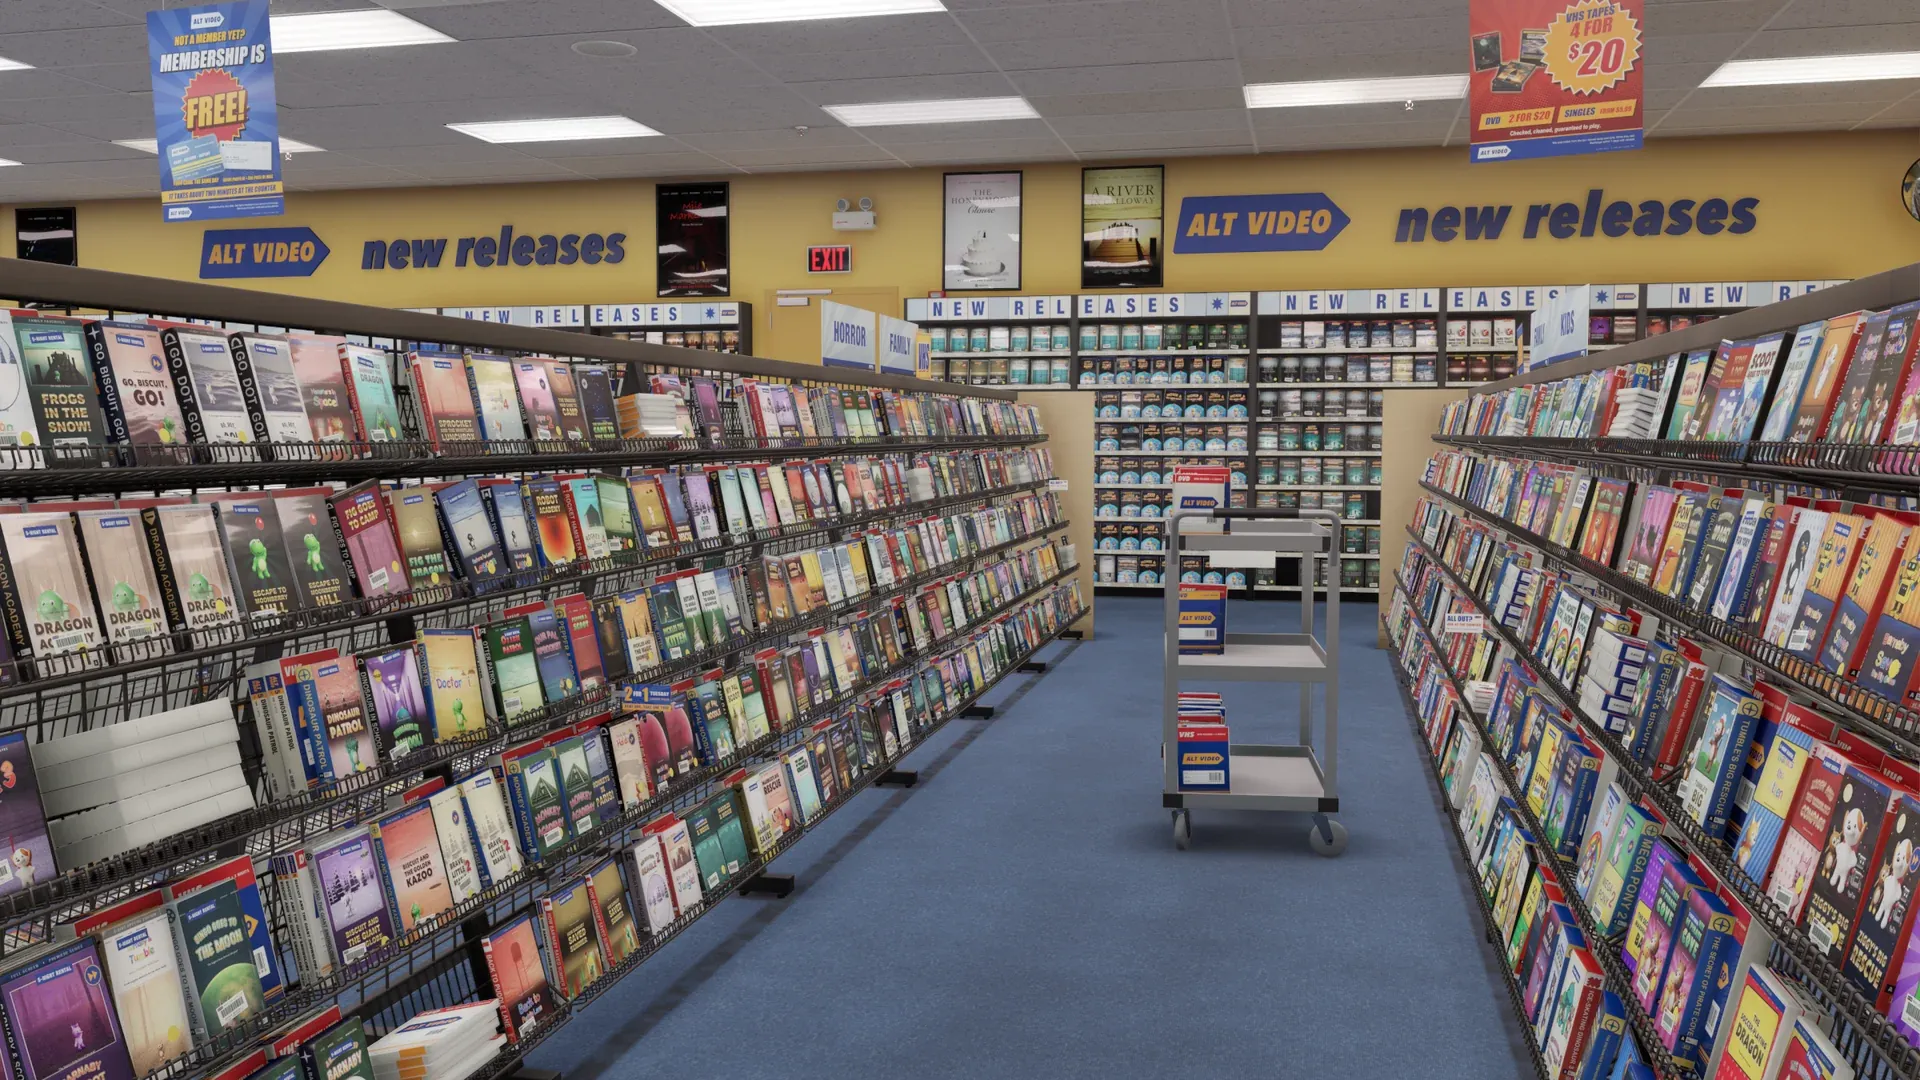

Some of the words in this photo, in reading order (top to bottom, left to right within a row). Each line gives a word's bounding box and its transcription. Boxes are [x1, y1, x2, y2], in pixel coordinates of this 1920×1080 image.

[193, 17, 203, 25] ALT
[204, 15, 221, 24] VIDEO
[1566, 10, 1585, 24] VHS
[1587, 4, 1616, 20] TAPES
[1570, 22, 1580, 39] 4
[1583, 16, 1613, 37] FOR
[174, 34, 189, 46] NOT
[189, 34, 196, 45] A
[196, 31, 227, 44] MEMBER
[228, 29, 247, 41] YET?
[160, 46, 249, 73] MEMBERSHIP
[250, 43, 266, 64] IS
[1568, 38, 1626, 77] $20
[186, 89, 246, 129] FREE!
[1485, 116, 1501, 126] DVD
[1508, 114, 1514, 123] 2
[1516, 112, 1532, 122] FOR
[1533, 110, 1551, 121] $20
[1564, 107, 1596, 118] SINGLES
[1510, 128, 1533, 137] Checked,
[1533, 126, 1553, 135] cleaned,
[1554, 124, 1583, 134] guaranteed
[1589, 122, 1602, 131] play.
[1492, 147, 1508, 155] VIDEO
[174, 191, 189, 200] TAKES
[189, 190, 205, 198] ABOUT
[217, 188, 237, 196] MINUTES
[245, 186, 254, 194] THE
[254, 184, 276, 193] COUNTER
[1092, 187, 1100, 196] A
[1106, 184, 1155, 197] RIVER
[1186, 212, 1239, 237] ALT
[1248, 209, 1332, 236] VIDEO
[1394, 205, 1513, 243] new
[1523, 188, 1761, 240] releases
[208, 242, 248, 265] ALT
[252, 240, 316, 264] VIDEO
[361, 237, 448, 271] new
[455, 225, 627, 268] releases
[811, 247, 846, 271] EXIT
[1286, 293, 1344, 311] NEW
[1679, 285, 1743, 304] NEW
[535, 305, 678, 325] RELEASES
[933, 300, 985, 317] NEW
[1014, 296, 1180, 316] RELEASES
[1560, 309, 1575, 336] KIDS
[48, 332, 64, 341] RENTAL
[834, 320, 867, 347] HORROR
[890, 332, 912, 356] FAMILY
[1750, 351, 1777, 369] SCOOT
[122, 378, 137, 388] GO,
[137, 379, 168, 389] BISCUIT,
[41, 393, 86, 405] FROGS
[133, 389, 166, 407] GO!
[44, 407, 61, 419] IN
[63, 407, 89, 419] THE
[48, 421, 92, 433] SNOW!
[438, 419, 472, 428] SPROCKET
[441, 432, 476, 441] LUNCHBOX
[344, 507, 357, 519] FIG
[357, 500, 376, 514] GOES
[536, 494, 559, 506] ROBOT
[539, 504, 561, 514] ACADEMY
[101, 520, 115, 528] 5-NIGHT
[115, 519, 130, 527] RENTAL
[348, 519, 359, 530] TO
[360, 512, 379, 527] CAMP
[25, 528, 42, 537] 5-NIGHT
[42, 527, 57, 536] RENTAL
[342, 549, 349, 560] TO
[409, 556, 422, 567] FIG
[425, 553, 443, 564] THE
[150, 527, 166, 572] DRAGON
[161, 573, 180, 621] ACADEMY
[411, 564, 445, 578] DRAGON
[253, 587, 276, 596] ESCAPE
[277, 586, 287, 595] TO
[308, 580, 330, 589] ESCAPE
[331, 578, 340, 587] TO
[4, 591, 26, 646] ACADEMY
[110, 607, 161, 625] DRAGON
[192, 611, 233, 626] ACADEMY
[34, 616, 94, 636] DRAGON
[436, 678, 462, 690] Doctor
[1655, 667, 1671, 702] PEPPER
[624, 686, 633, 702] 2
[642, 687, 649, 702] 1
[650, 690, 670, 698] TUESDAY
[326, 706, 361, 725] DINOSAUR
[1654, 702, 1660, 710] &
[303, 683, 318, 733] DINOSAUR
[314, 734, 328, 770] PATROL
[329, 719, 364, 740] PATROL
[267, 733, 277, 755] PATROL
[285, 728, 294, 751] PATROL
[1731, 719, 1751, 763] TUMBLE'S
[1728, 764, 1737, 780] BIG
[1691, 789, 1704, 808] BIG
[1715, 781, 1731, 817] RESCUE
[502, 839, 511, 852] 2
[402, 857, 419, 870] BISCUIT
[1632, 838, 1653, 873] MEGA
[464, 859, 472, 872] 2
[405, 867, 434, 888] KAZOO
[1620, 875, 1641, 911] PONY
[228, 916, 238, 927] TO
[1656, 898, 1675, 927] COVE
[1811, 893, 1837, 920] ZIGGY'S
[1835, 910, 1850, 931] BIG
[345, 920, 368, 940] BISCUIT
[361, 925, 382, 942] GIANT
[195, 941, 215, 962] THE
[213, 928, 245, 953] MOON
[1681, 928, 1700, 960] COVE
[1714, 936, 1722, 949] THE
[1857, 931, 1877, 955] ZIGGY'S
[1876, 948, 1888, 968] BIG
[1707, 951, 1717, 978] SECRET
[1850, 944, 1884, 989] RESCUE
[485, 954, 494, 971] BACK
[502, 1009, 511, 1029] LANE
[1703, 979, 1709, 988] OF
[1580, 990, 1594, 1031] ICE-SKATING
[1695, 989, 1706, 1017] PIRATE
[1688, 1018, 1697, 1037] COVE
[1753, 1014, 1761, 1026] THE
[1741, 1012, 1767, 1050] SOCCER-PLAYING
[1571, 1031, 1583, 1065] DINOSAUR
[1735, 1022, 1765, 1067] DRAGON
